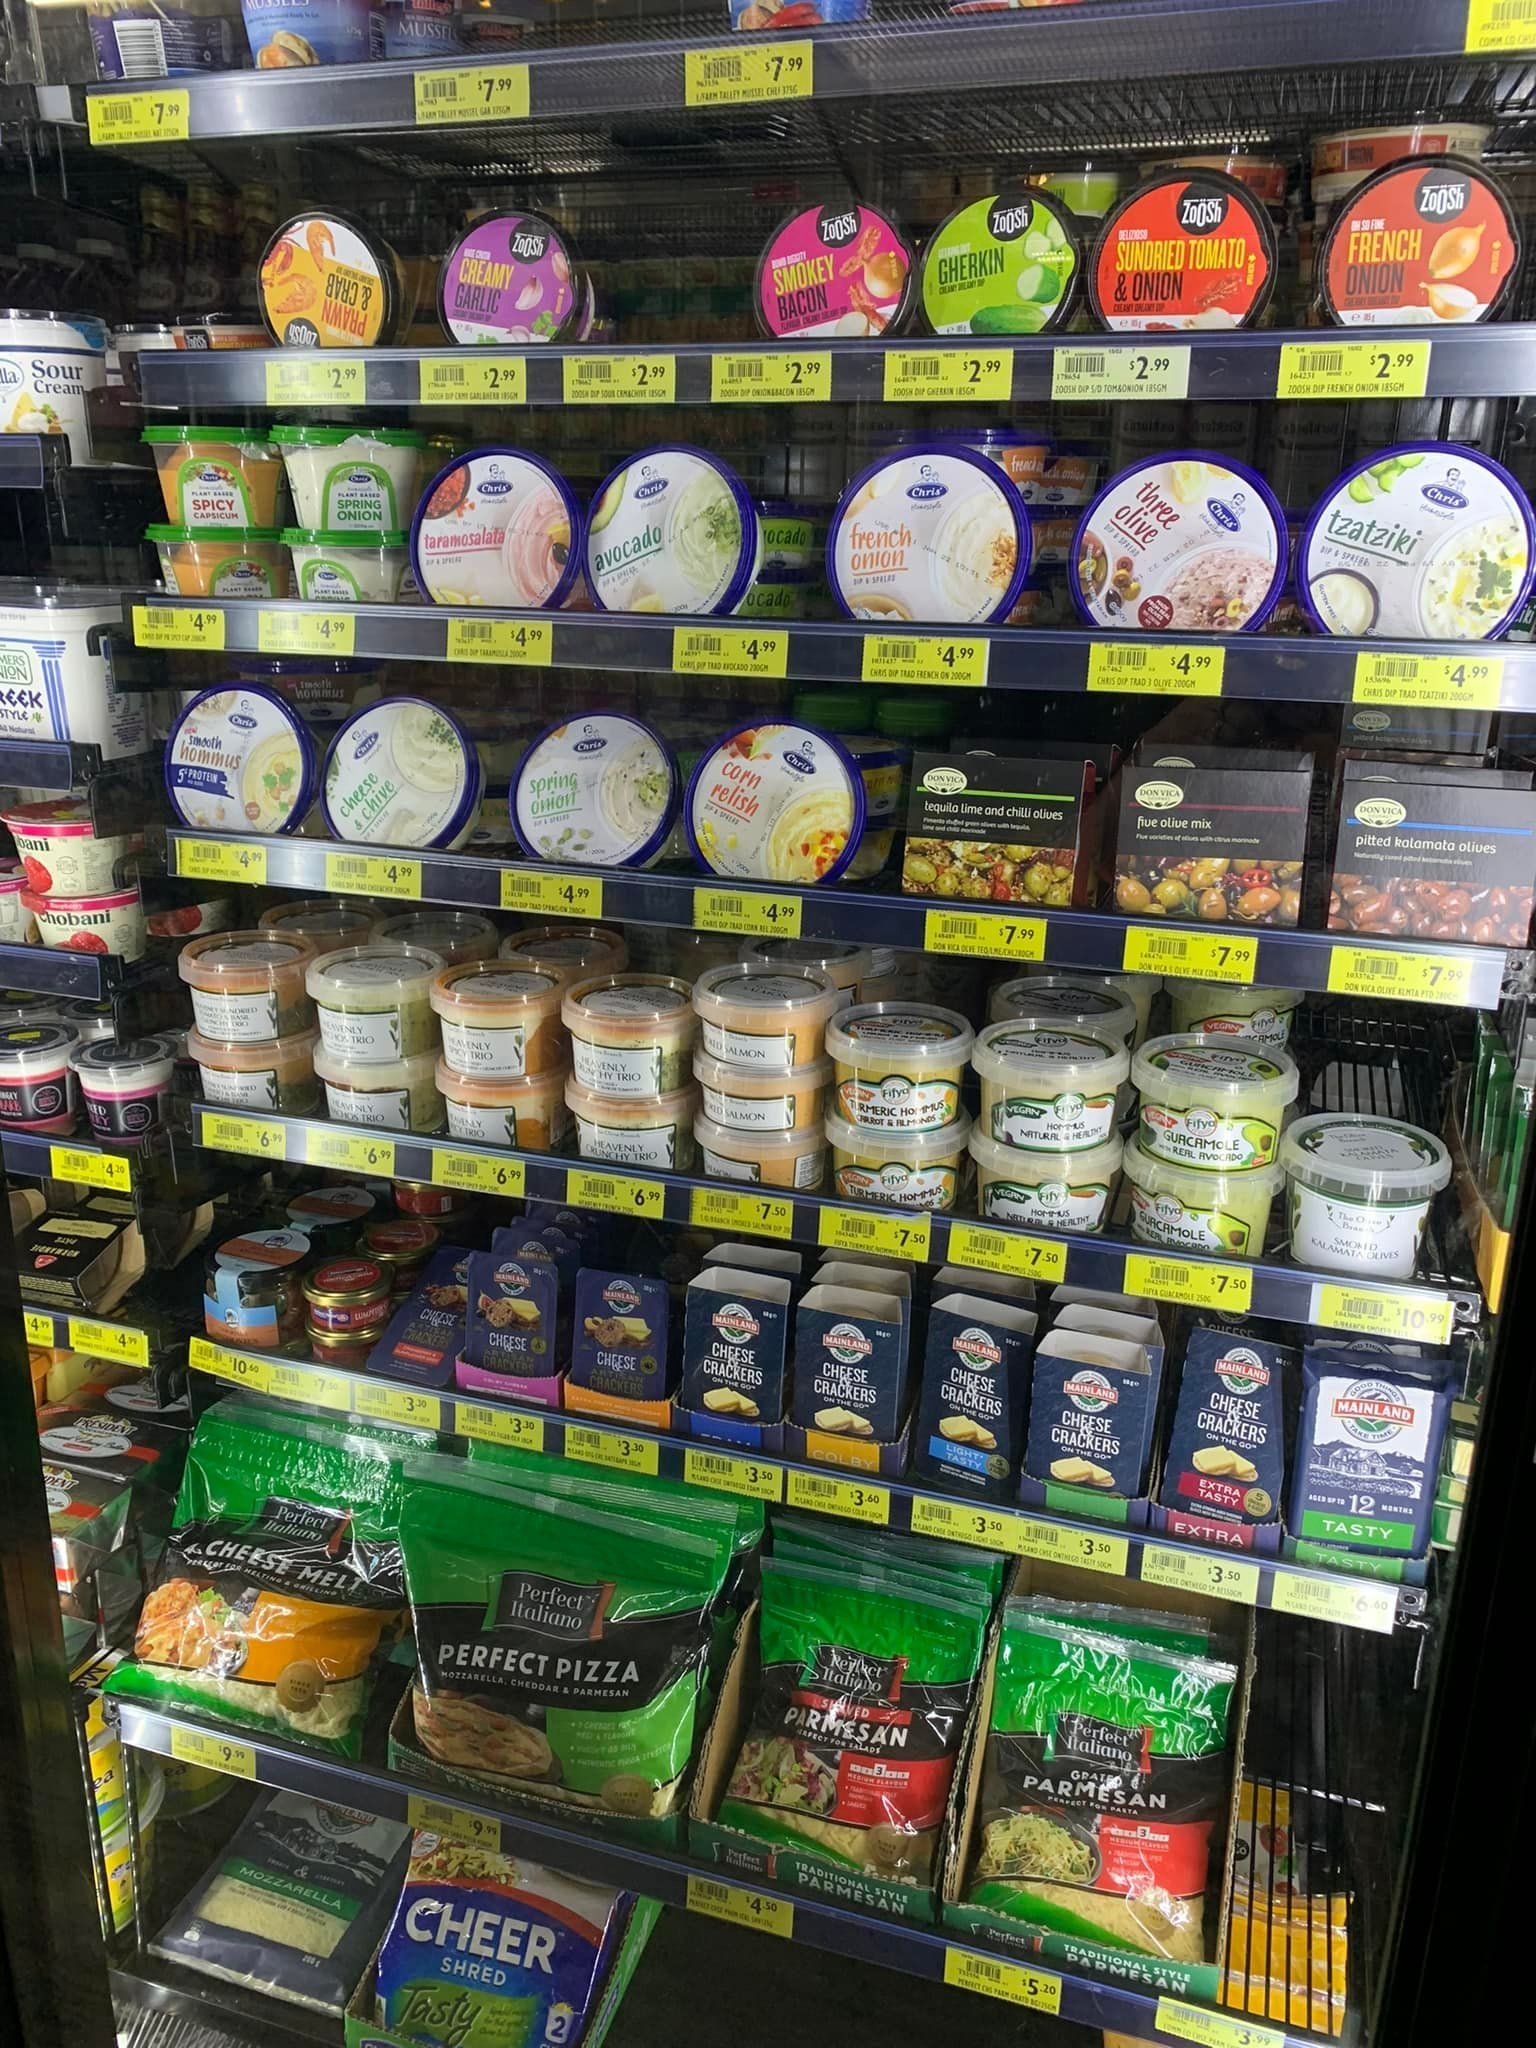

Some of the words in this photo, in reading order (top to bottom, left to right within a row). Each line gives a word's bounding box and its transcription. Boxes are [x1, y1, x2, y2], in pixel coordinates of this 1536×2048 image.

[764, 56, 803, 82] $7.99
[1115, 240, 1185, 272] SUNDRIED
[1188, 237, 1246, 270] TOMATO
[1348, 228, 1423, 264] FRENCH
[459, 257, 515, 290] CREAMY
[773, 253, 835, 297] SMOKEY
[938, 247, 1005, 286] GHERKIN
[325, 274, 359, 307] CRAB
[1114, 275, 1128, 302] &
[1132, 272, 1183, 301] ONION
[1346, 263, 1404, 296] ONION
[454, 281, 501, 315] GARLIC
[777, 286, 829, 323] BACON
[320, 298, 369, 338] PRAWN
[31, 359, 84, 380] Sour
[484, 367, 516, 389] $2.99
[963, 359, 1001, 382] $2.99
[1128, 356, 1170, 379] $2.99
[34, 379, 85, 395] Cream
[192, 499, 234, 512] SPICY
[193, 511, 239, 520] CAPSICUM
[336, 510, 383, 521] ONION
[337, 499, 382, 510] SPRING
[1135, 481, 1180, 530] three
[849, 521, 911, 549] french
[1115, 505, 1159, 545] olive
[1327, 509, 1423, 556] tzatziki
[423, 527, 506, 551] taramosalata
[594, 523, 663, 571] avocado
[850, 550, 904, 571] onion
[190, 613, 217, 632] $4.99
[510, 628, 543, 646] $4.99
[937, 646, 974, 668] $4.99
[1170, 652, 1211, 676] $4.99
[188, 733, 223, 750] smooth
[179, 739, 242, 770] hommus
[188, 768, 218, 784] PROTEIN
[529, 769, 579, 797] spring
[721, 762, 762, 789] corn
[339, 770, 379, 818] cheese
[362, 778, 396, 820] chive
[530, 788, 577, 816] onion
[711, 783, 760, 818] relish
[924, 799, 959, 815] tequila
[960, 802, 983, 815] lime
[984, 804, 1005, 817] and
[1006, 805, 1031, 818] chilli
[1033, 807, 1064, 821] olives
[1359, 806, 1379, 815] DON
[1137, 815, 1158, 829] five
[1160, 816, 1188, 829] olive
[1190, 818, 1212, 830] mix
[1355, 834, 1392, 849] pitted
[1394, 836, 1456, 852] kalamata
[1458, 840, 1497, 855] olives
[558, 884, 590, 903] $4.99
[39, 910, 111, 926] Chobani
[1210, 945, 1250, 966] $7.99
[594, 1138, 645, 1153] HEAVENLY
[1020, 1127, 1061, 1141] NATURAL
[1072, 1127, 1103, 1141] HEALTHY
[1162, 1130, 1240, 1151] GUACAMOLE
[632, 1150, 657, 1161] TRIO
[1172, 1147, 1197, 1161] REAL
[1199, 1150, 1244, 1161] AVOCADO
[630, 1188, 661, 1206] $6.99
[849, 1184, 897, 1202] TURMERIC
[899, 1185, 943, 1202] HOMMUS
[894, 1229, 926, 1248] $7.50
[1366, 1249, 1400, 1260] OLIVES
[1210, 1274, 1247, 1293] $7.50
[822, 1361, 869, 1384] CHEESE
[813, 1379, 877, 1405] CRACKERS
[1209, 1392, 1261, 1420] CHEESE
[1337, 1400, 1411, 1421] MAINLAND
[1197, 1412, 1268, 1444] CRACKERS
[812, 1449, 874, 1470] COLBY
[946, 1452, 983, 1470] TASTY
[745, 1466, 774, 1483] $3.50
[1197, 1488, 1240, 1507] TASTY
[1199, 1478, 1242, 1497] EXTRA
[1348, 1494, 1376, 1516] 12
[1382, 1504, 1414, 1514] MONTHS
[1175, 1521, 1245, 1545] EXTRA
[1322, 1518, 1393, 1539] TASTY
[205, 1539, 295, 1576] CHEESE
[298, 1566, 369, 1589] MELT
[1207, 1565, 1241, 1583] $3.50
[519, 1581, 586, 1612] Perfect
[510, 1601, 583, 1630] Italiano
[438, 1643, 550, 1678] PERFECT
[555, 1657, 641, 1684] PIZZA
[510, 1678, 560, 1693] CHEDDAR
[573, 1687, 630, 1698] PARMESAN
[784, 1707, 909, 1748] PARMESAN
[1023, 1774, 1167, 1809] PARMESAN
[239, 1865, 343, 1911] MOZZARELLA
[796, 1861, 872, 1893] TRADITIONAL
[874, 1887, 909, 1903] STYLE
[798, 1872, 904, 1914] PARMESAN
[405, 1897, 556, 1974] CHEER
[440, 1956, 507, 1986] SHRED
[1022, 1976, 1056, 1997] $5.20
[392, 1986, 482, 2047] Tasty
